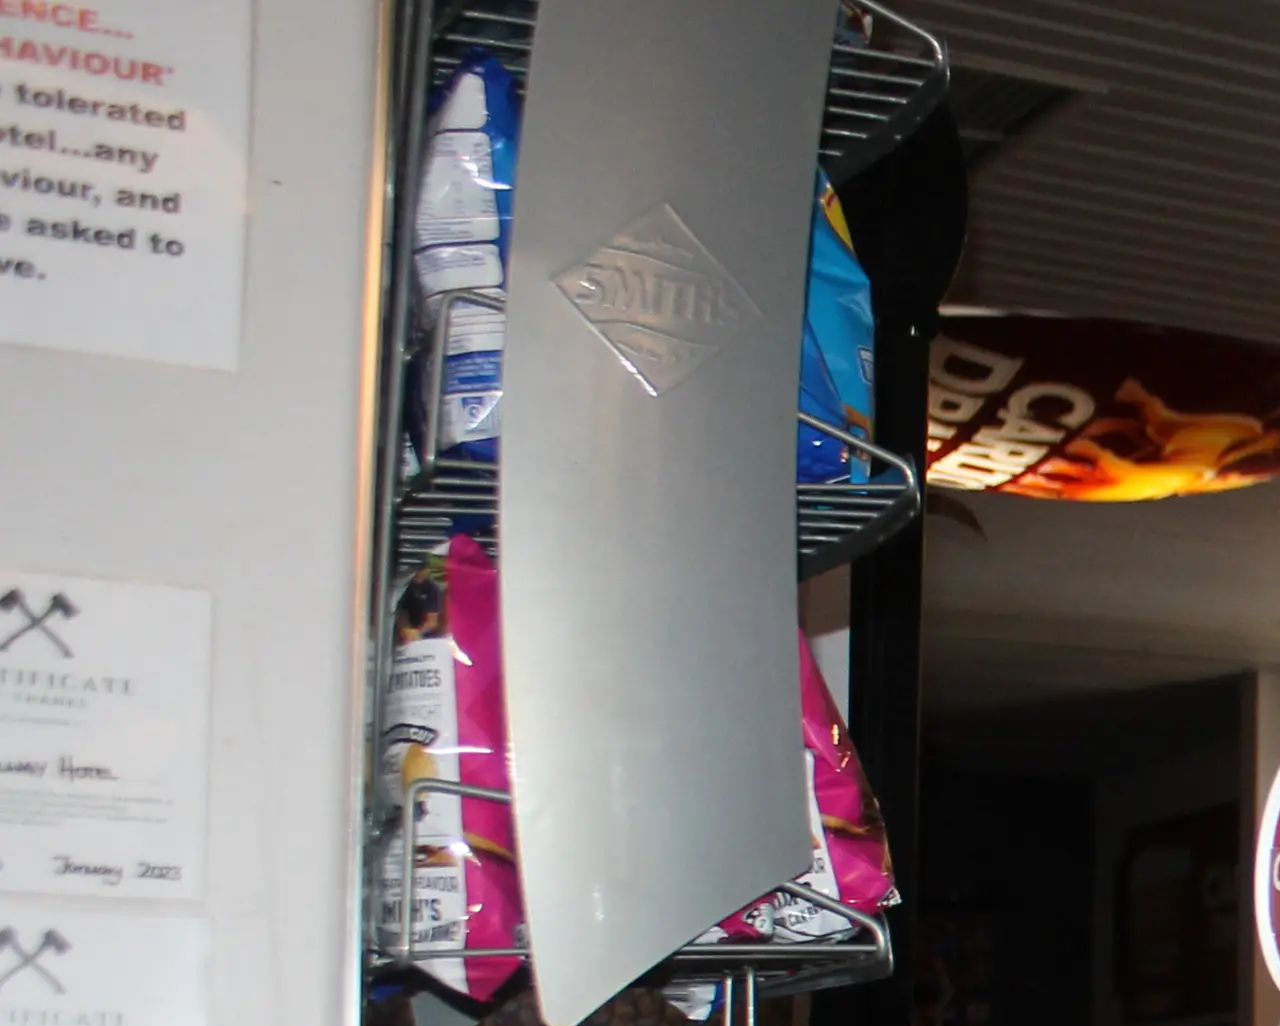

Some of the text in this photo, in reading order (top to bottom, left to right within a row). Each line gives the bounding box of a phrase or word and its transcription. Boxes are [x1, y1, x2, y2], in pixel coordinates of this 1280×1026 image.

[16, 83, 187, 131] tolerated
[115, 189, 182, 214] and
[27, 219, 136, 250] asked
[150, 233, 185, 257] to
